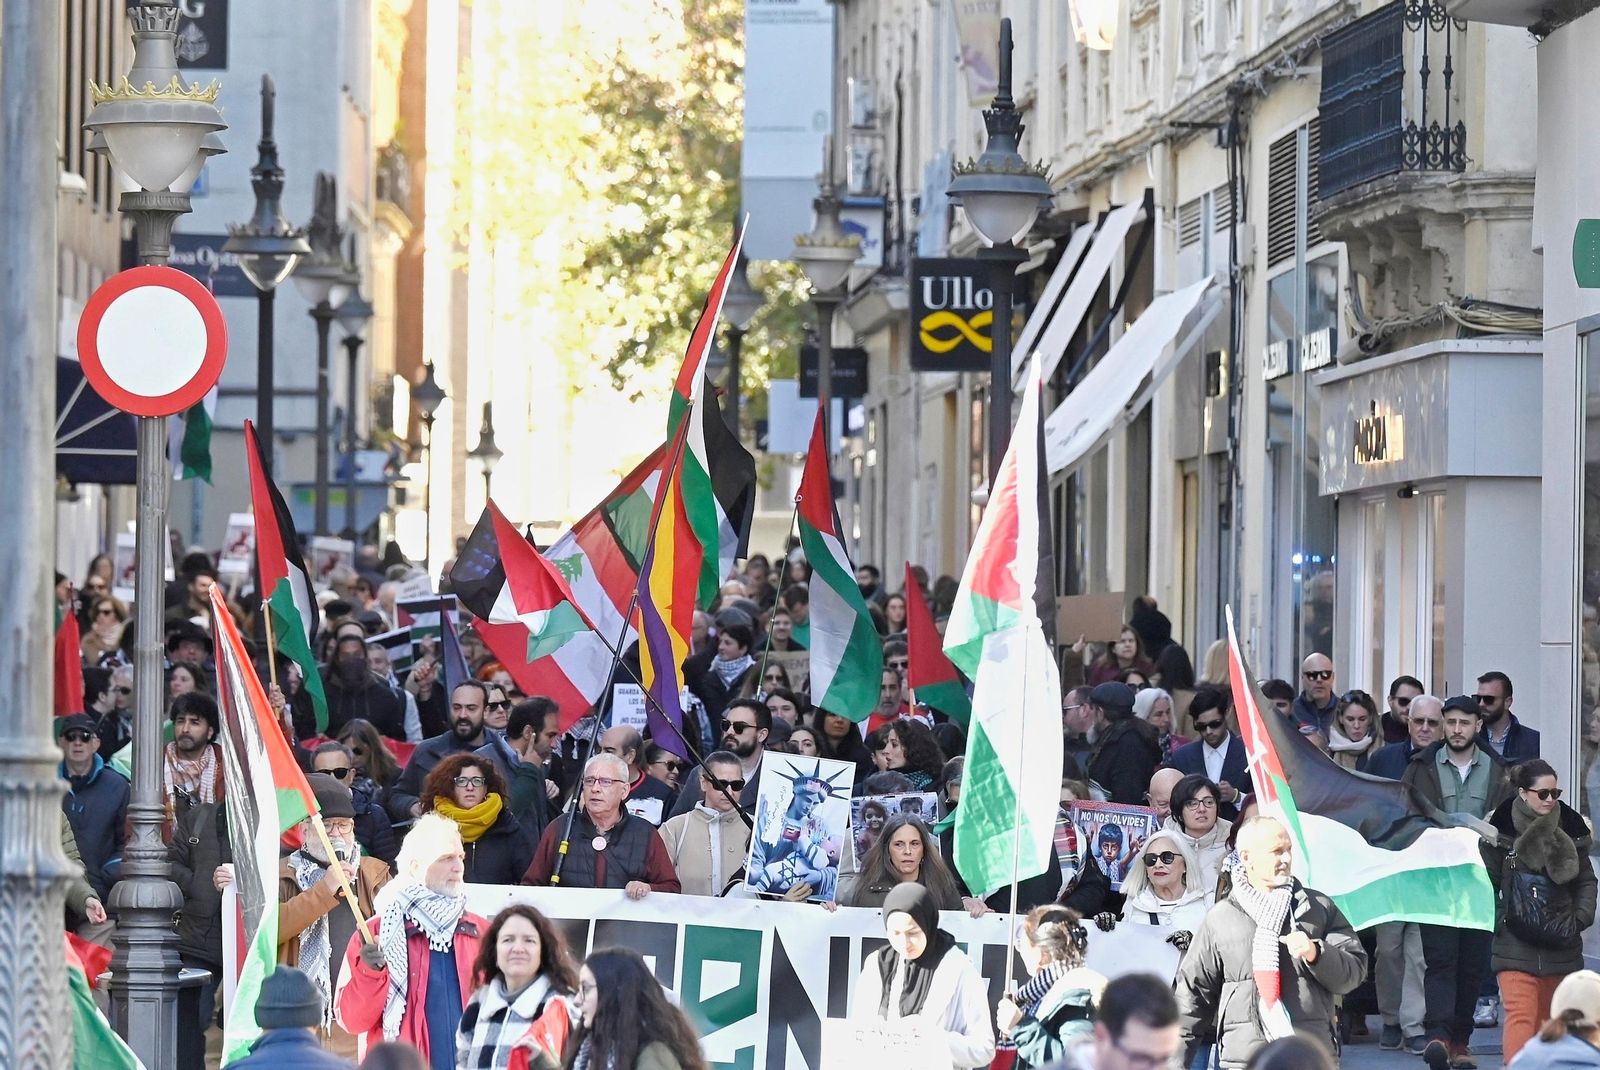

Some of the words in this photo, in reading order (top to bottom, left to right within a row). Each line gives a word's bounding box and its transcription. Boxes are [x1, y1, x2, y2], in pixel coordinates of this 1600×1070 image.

[920, 276, 994, 310] Ullo
[1081, 812, 1091, 820] NO
[1094, 812, 1110, 823] NOS
[1112, 815, 1145, 827] OLVIDES
